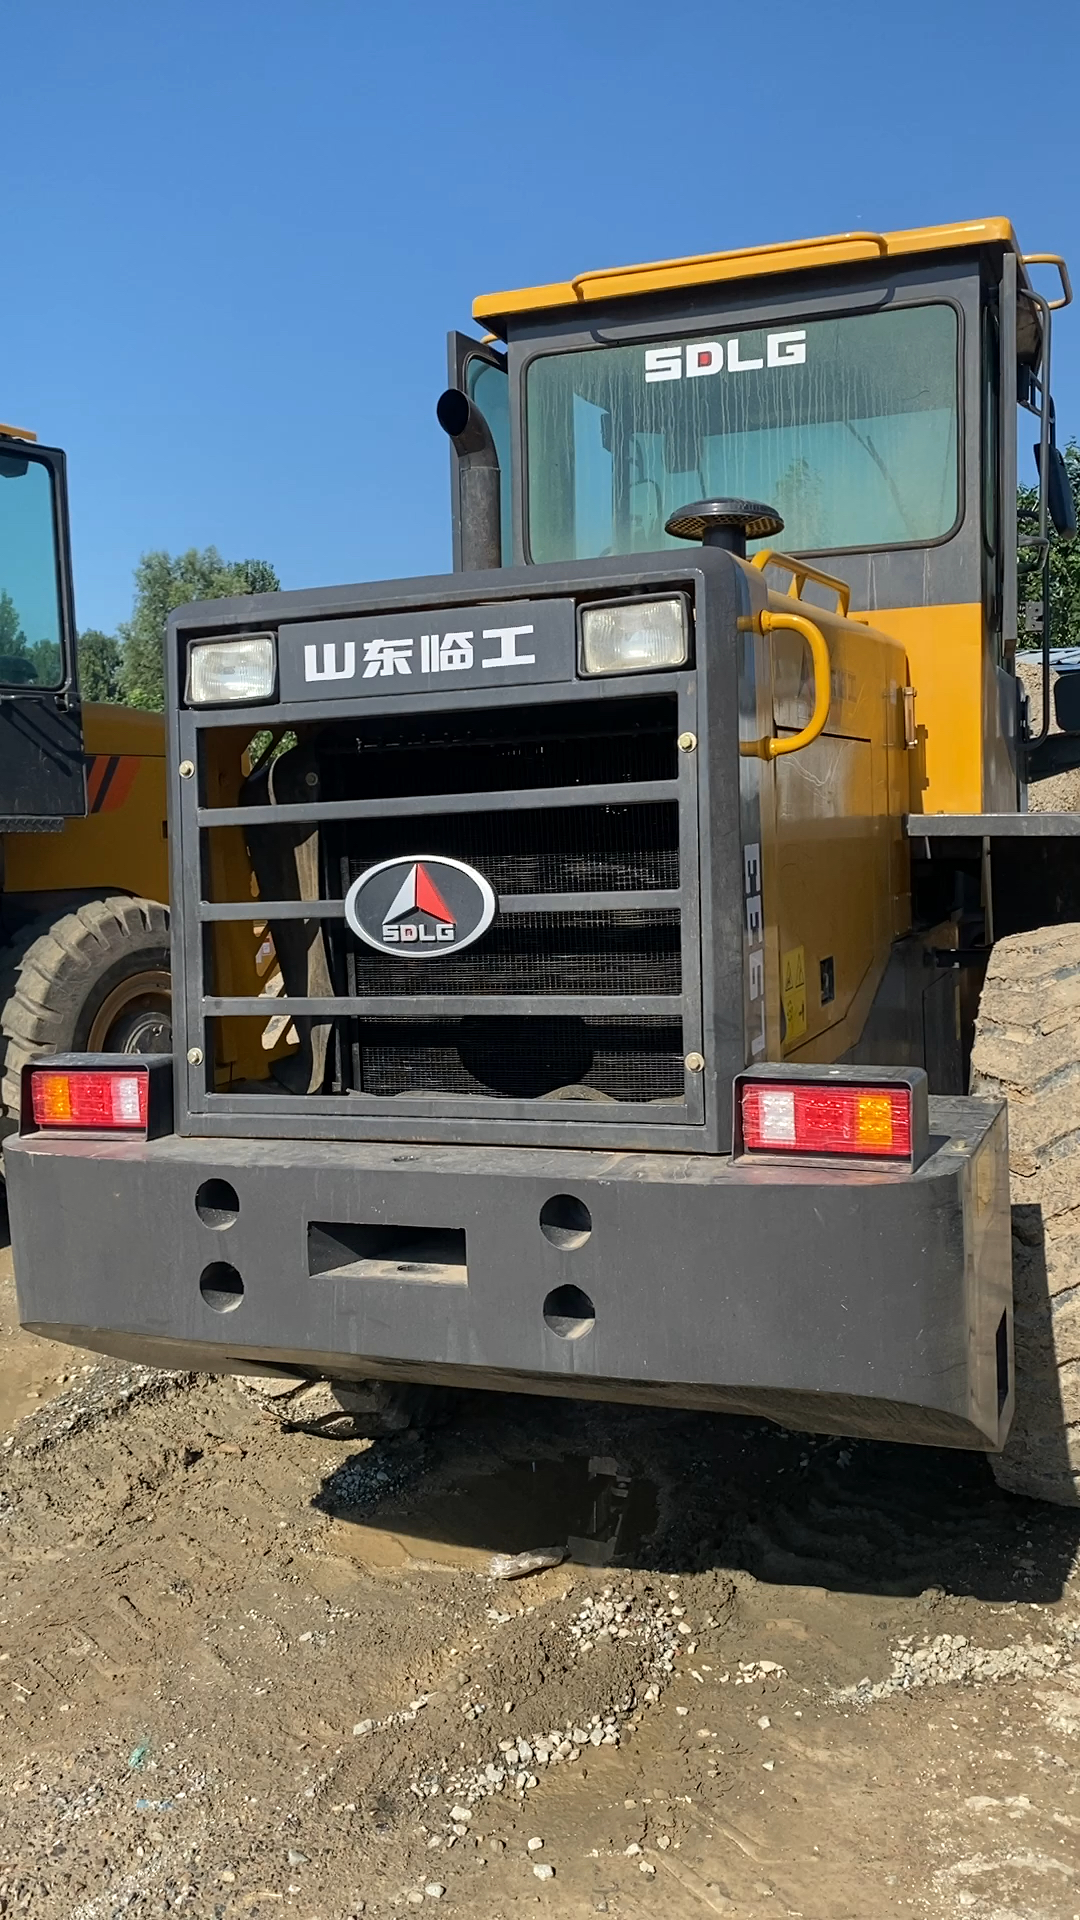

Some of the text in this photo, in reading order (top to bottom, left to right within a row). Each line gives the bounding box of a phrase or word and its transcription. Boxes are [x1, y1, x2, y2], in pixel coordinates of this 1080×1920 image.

[645, 330, 806, 383] SDLG
[304, 624, 536, 682] 山东临工
[382, 924, 455, 943] SDLG
[744, 843, 766, 1056] L933
